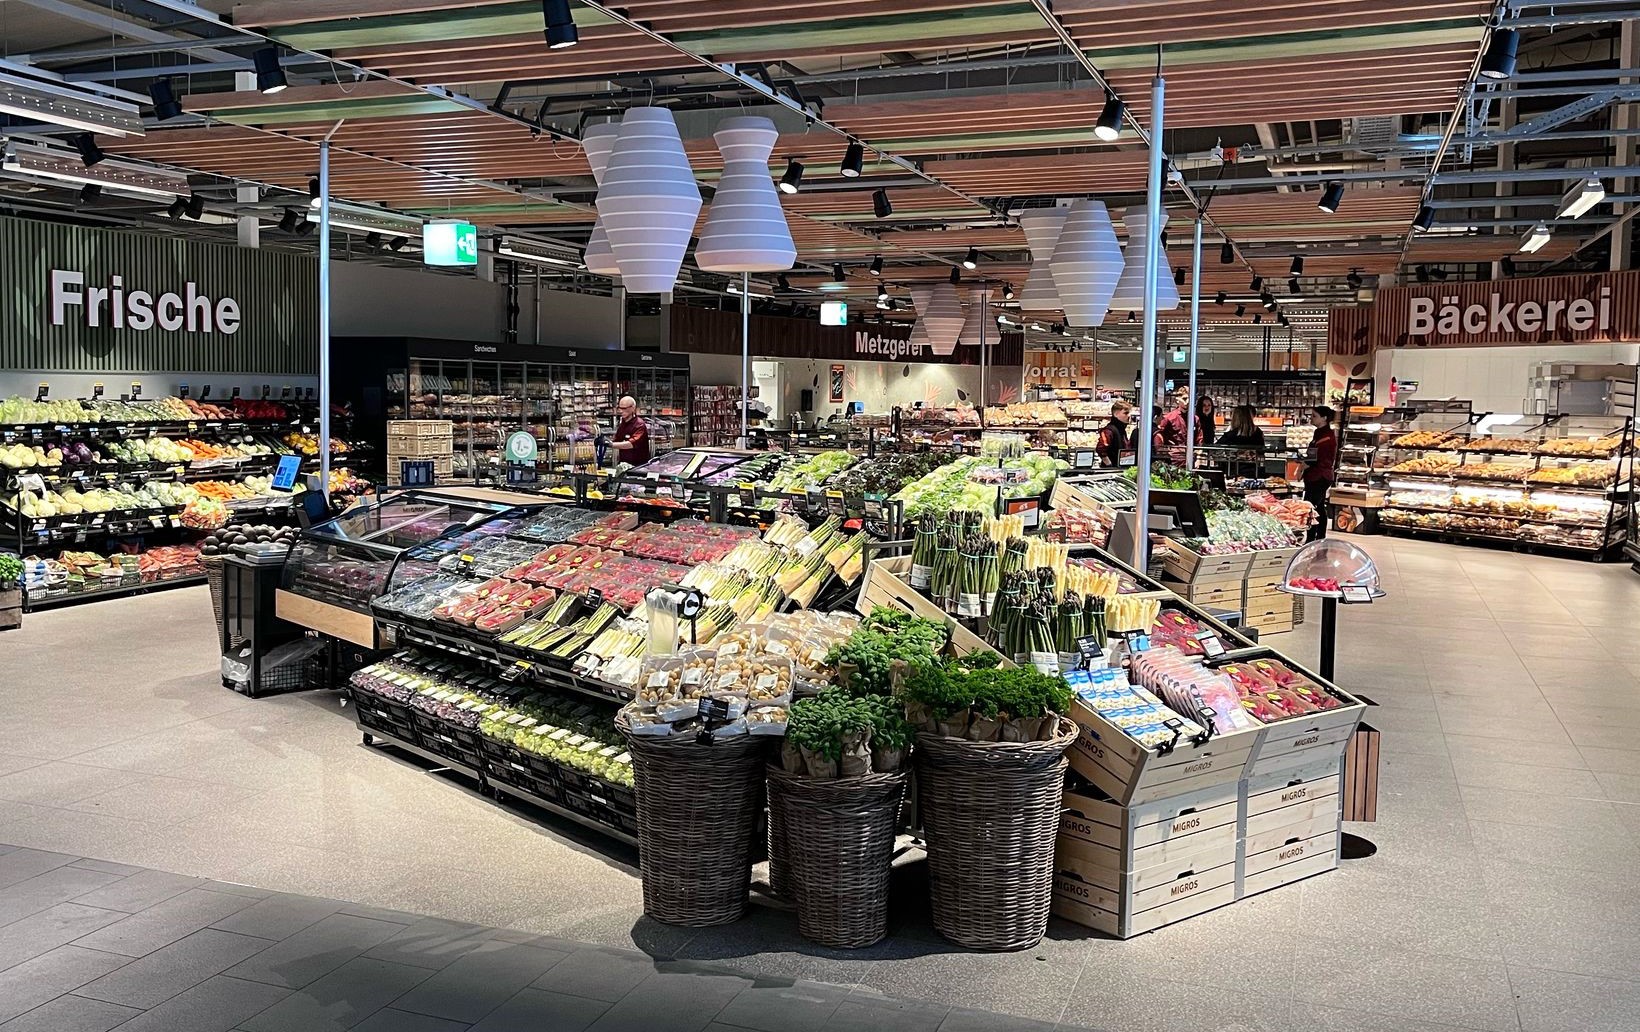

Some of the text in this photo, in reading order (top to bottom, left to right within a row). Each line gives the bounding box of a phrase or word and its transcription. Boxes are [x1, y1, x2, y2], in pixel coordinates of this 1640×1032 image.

[52, 269, 241, 335] Frische
[1409, 287, 1611, 336] Bäckerei
[1293, 735, 1320, 748] MIGROS
[1183, 761, 1213, 775] MIGROS
[1281, 788, 1307, 803] MIGROS
[1172, 818, 1200, 834] MIGROS
[1278, 846, 1304, 861] MIGROS
[1170, 879, 1199, 896] MIGROS
